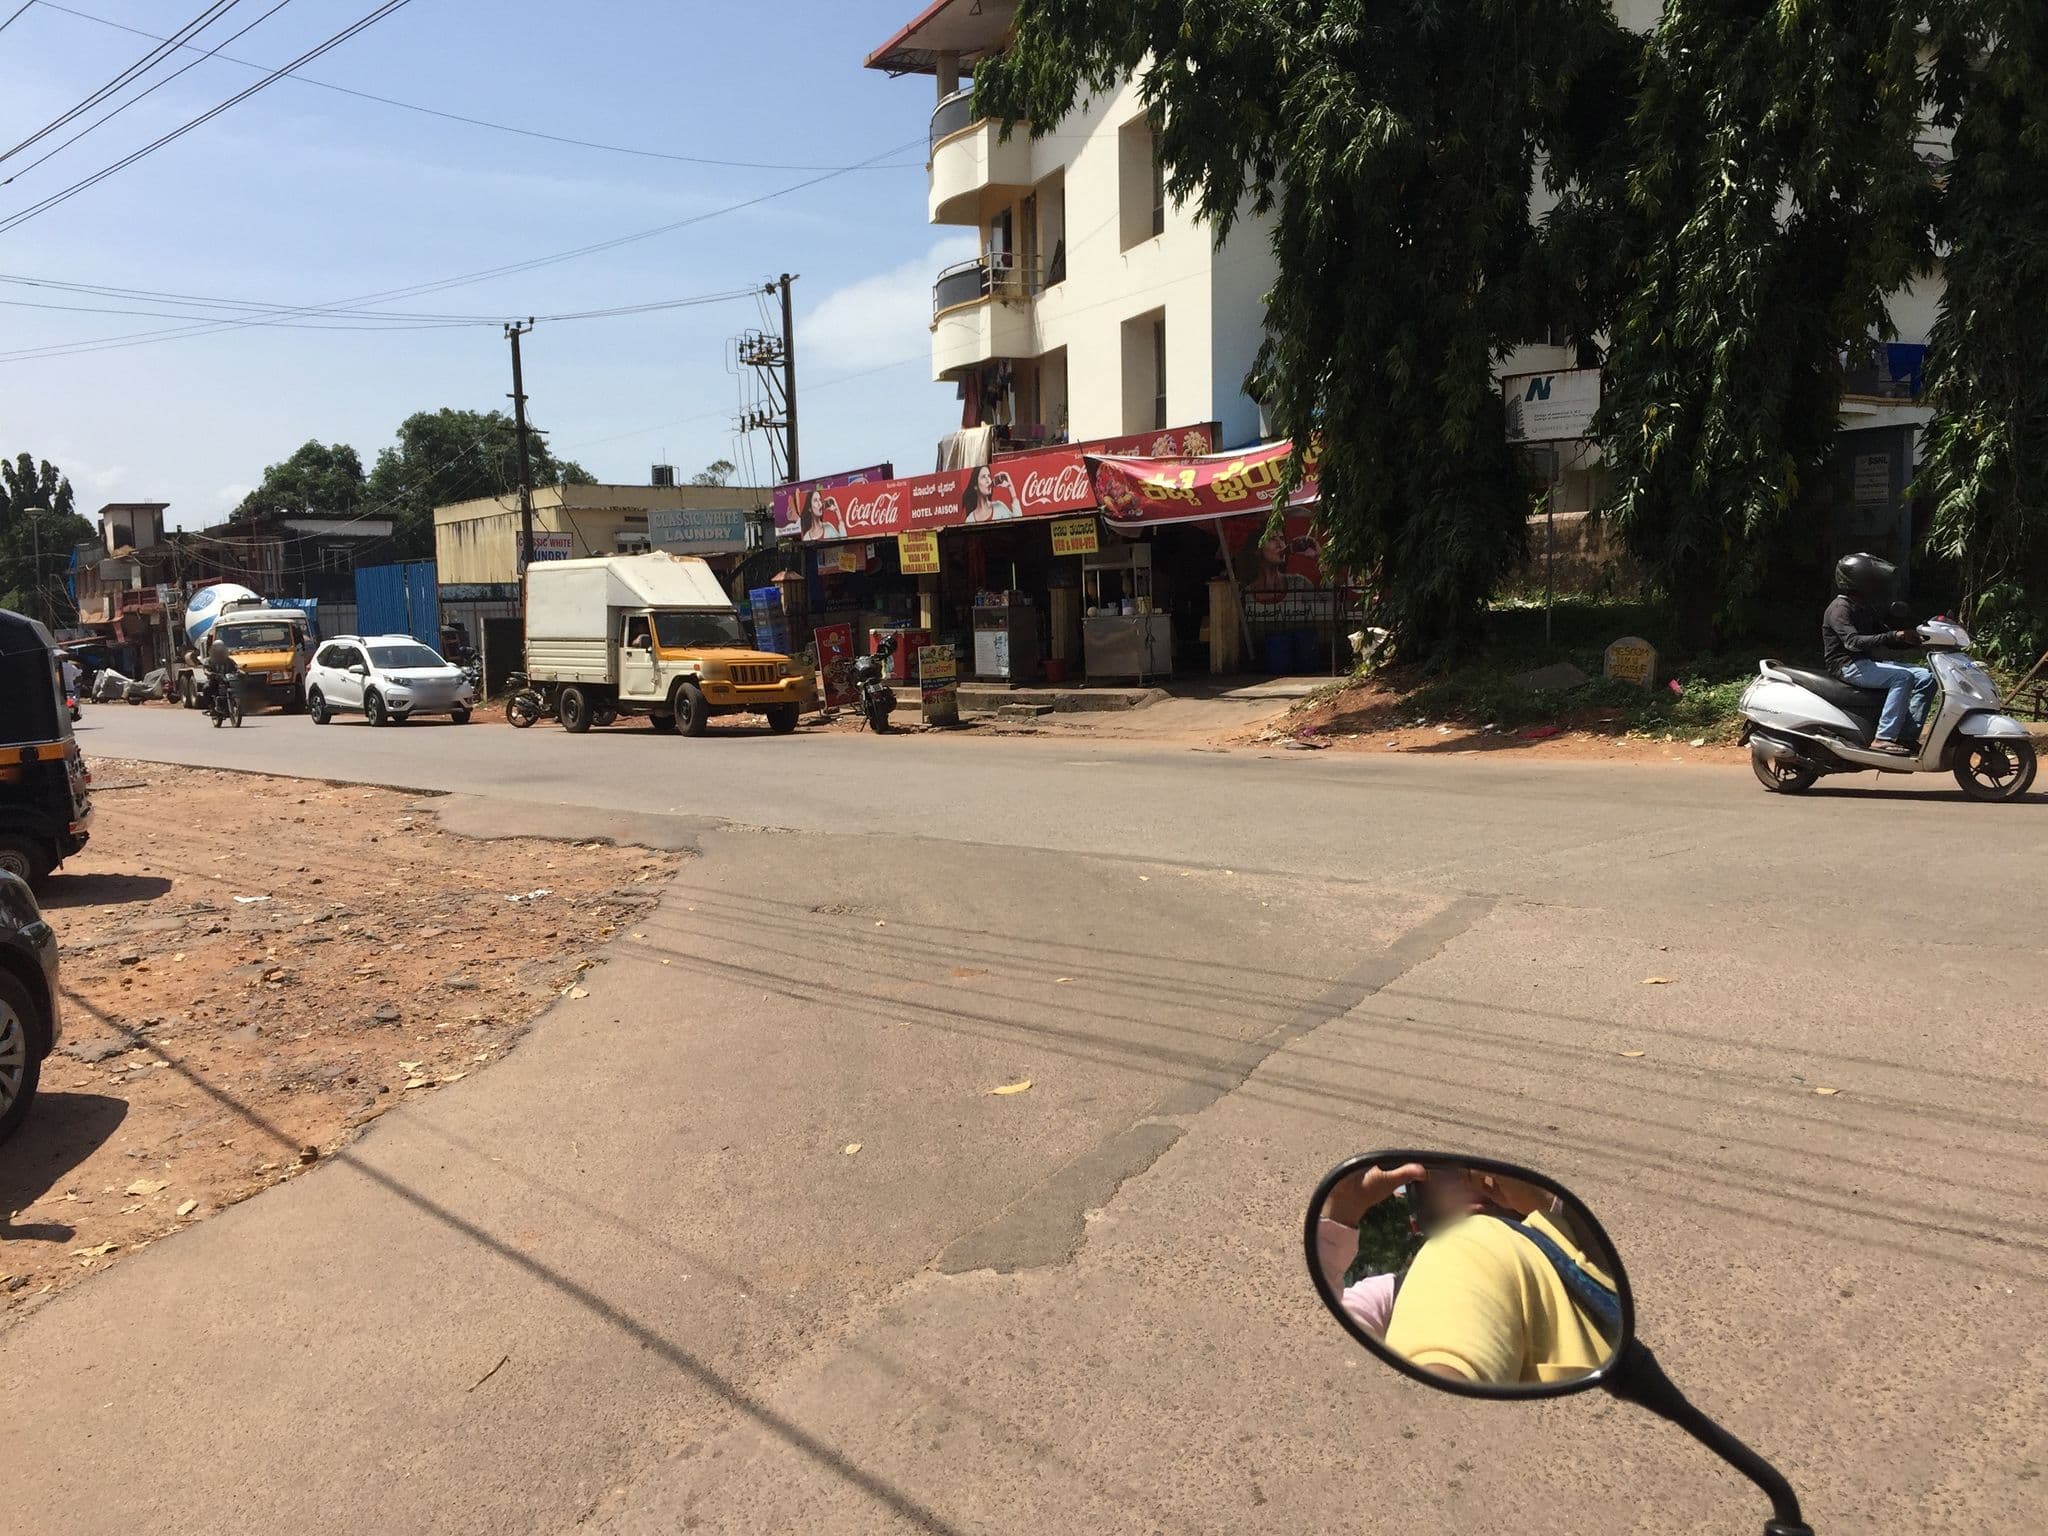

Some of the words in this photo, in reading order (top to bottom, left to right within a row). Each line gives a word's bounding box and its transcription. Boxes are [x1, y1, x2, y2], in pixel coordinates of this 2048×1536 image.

[1021, 465, 1089, 507] Coca-Cola
[845, 492, 900, 529] Coca-Cola
[911, 507, 933, 518] HOTEL
[933, 504, 959, 516] JAISON
[655, 511, 700, 528] CLASSIC
[704, 511, 740, 526] WHITE
[518, 537, 548, 548] CSSIC
[549, 538, 572, 548] WHITE
[664, 527, 732, 542] LAUNDRY
